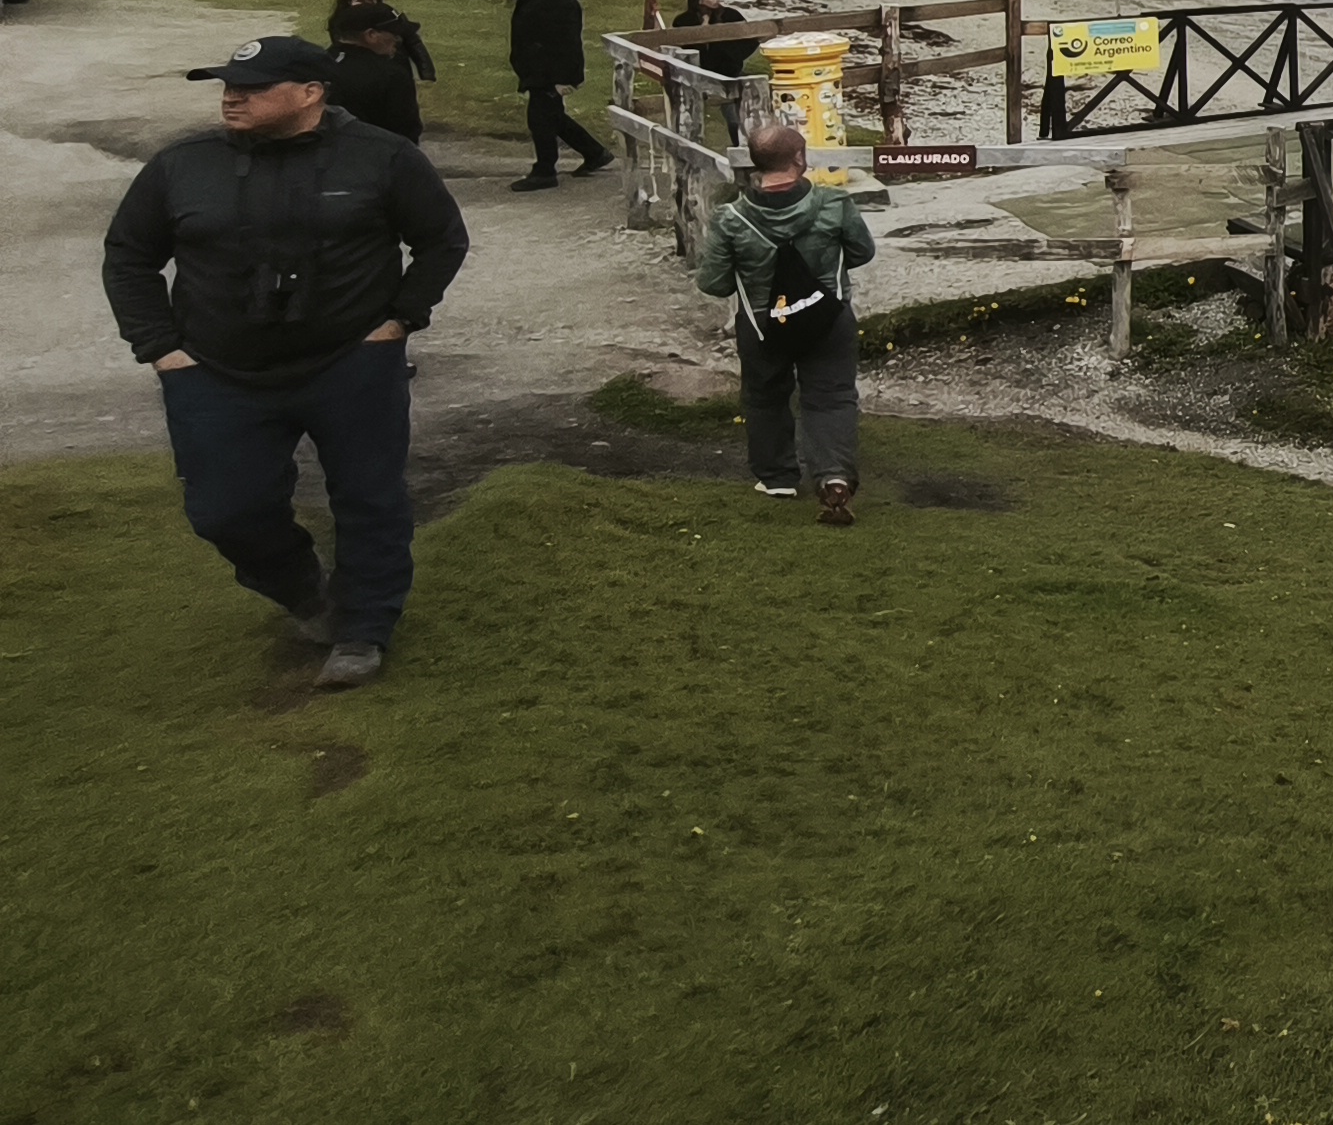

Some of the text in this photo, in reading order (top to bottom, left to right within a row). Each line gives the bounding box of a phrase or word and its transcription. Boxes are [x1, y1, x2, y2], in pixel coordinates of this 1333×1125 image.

[1093, 36, 1133, 46] Correo
[1094, 44, 1152, 57] Argentino
[878, 153, 970, 165] CLAUSURADO
